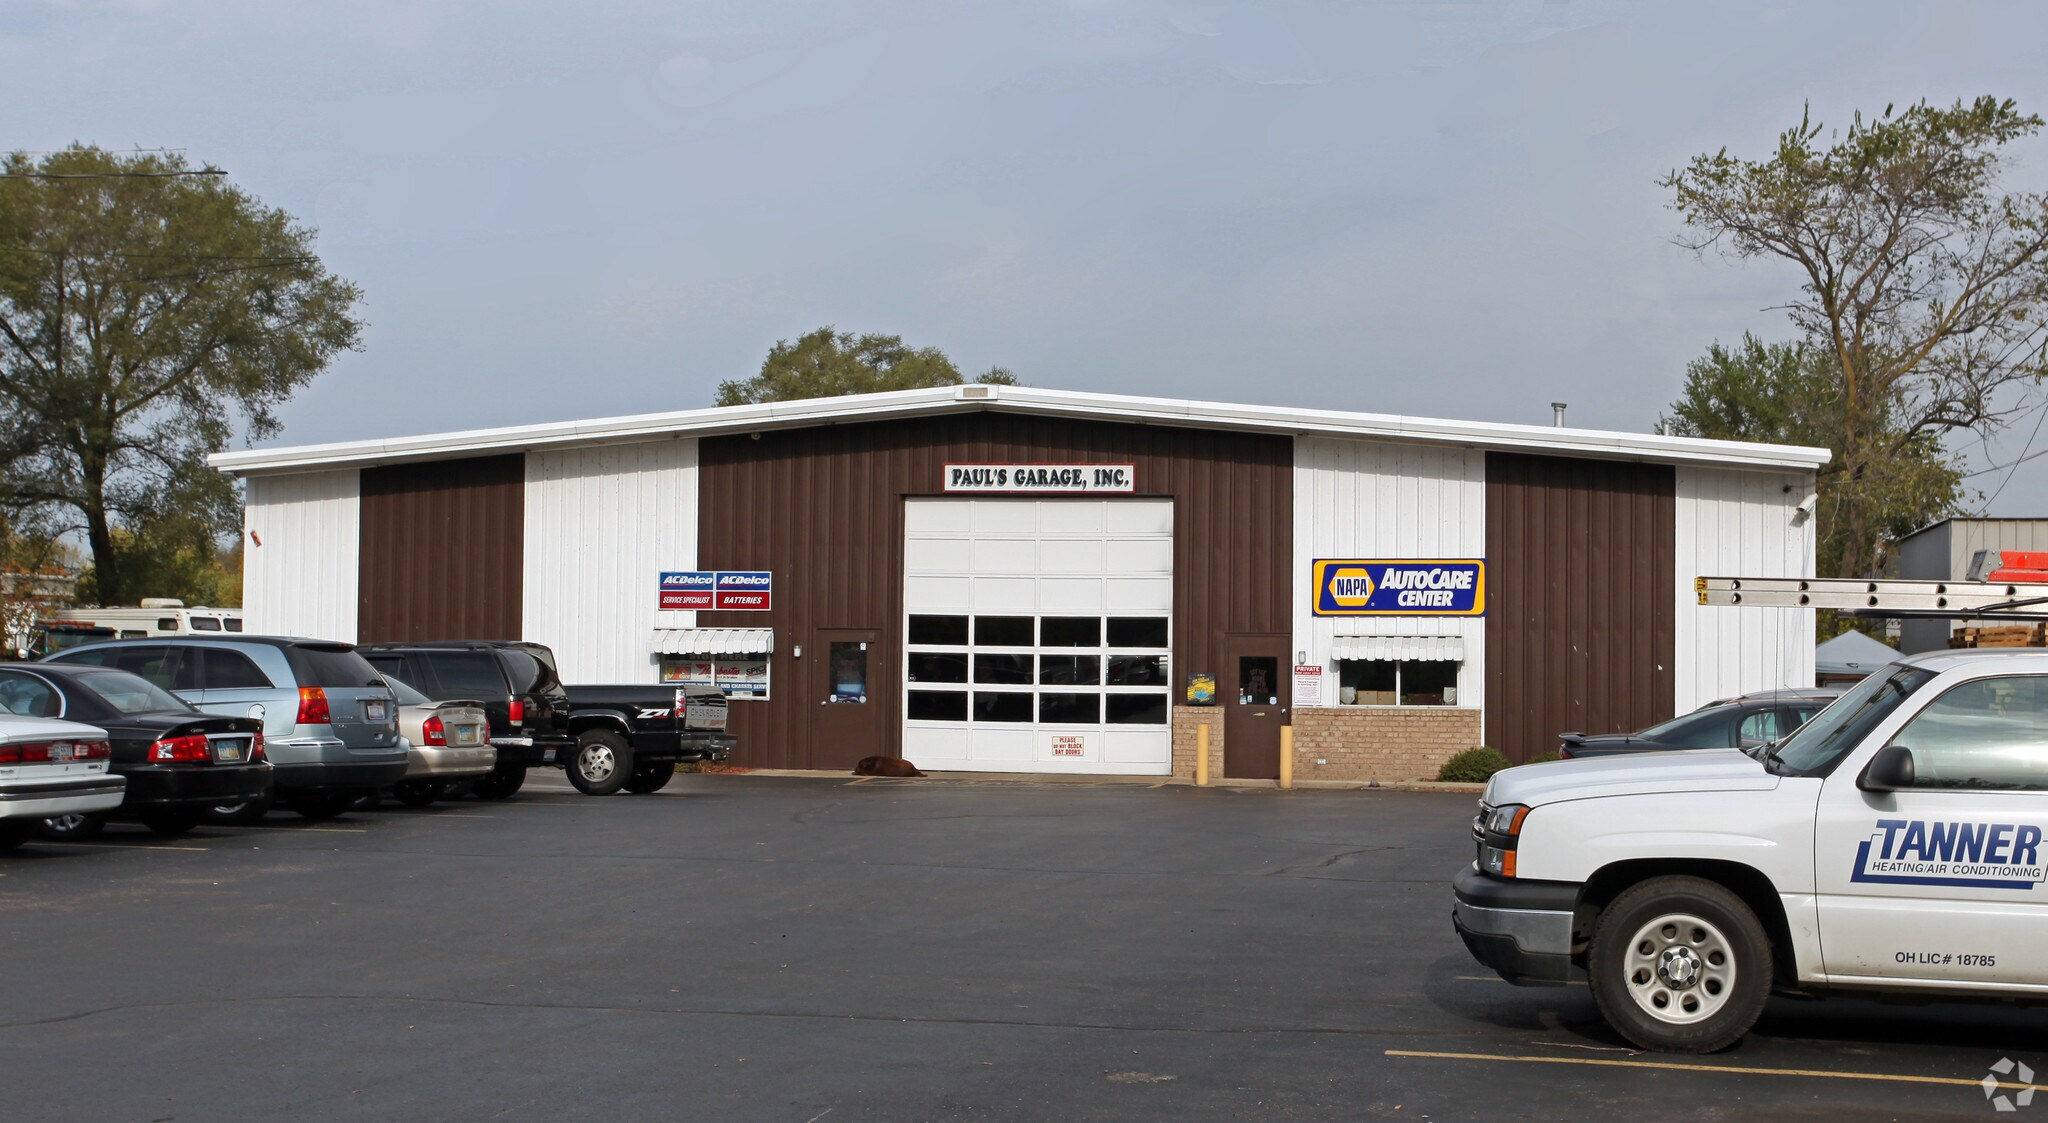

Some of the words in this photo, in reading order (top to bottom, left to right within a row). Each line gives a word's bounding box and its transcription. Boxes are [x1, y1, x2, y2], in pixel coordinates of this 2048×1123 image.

[951, 468, 1007, 487] PAUL'S
[1013, 468, 1087, 490] GARAGE,
[1093, 468, 1130, 487] INC.
[663, 575, 713, 584] ACDelco
[719, 575, 770, 584] ACDelco
[1336, 578, 1368, 596] NAPA
[662, 596, 683, 604] SERVICE
[683, 596, 711, 604] SPECIALIST
[723, 596, 763, 604] BATTERIES
[1397, 590, 1453, 607] CENTER
[636, 708, 671, 719] Z71
[1875, 818, 2042, 866] TANNER
[1871, 861, 1948, 874] HEATING/AIR
[1952, 864, 2041, 878] CONDITIONING
[1895, 951, 1916, 964] OH
[1957, 954, 1996, 967] 18785
